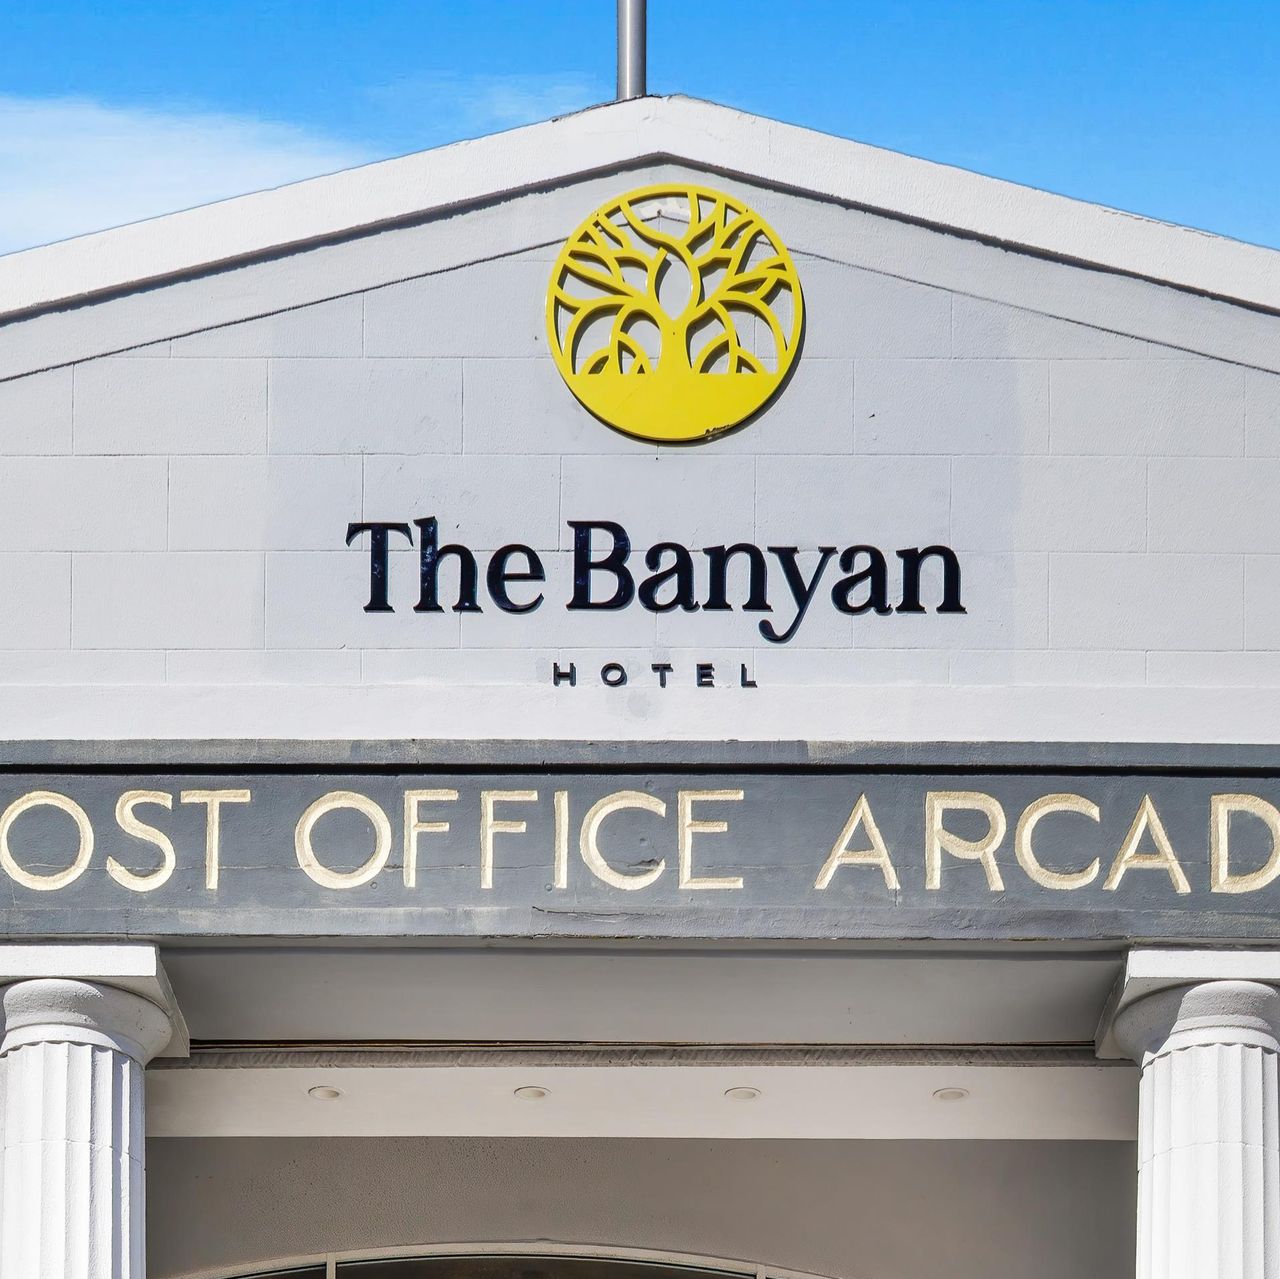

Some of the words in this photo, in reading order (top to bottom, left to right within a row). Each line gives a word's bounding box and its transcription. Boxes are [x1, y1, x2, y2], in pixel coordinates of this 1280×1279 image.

[345, 516, 546, 614] The
[566, 519, 968, 644] Banyan
[552, 661, 758, 689] HOTEL
[295, 789, 745, 891] OFFICE
